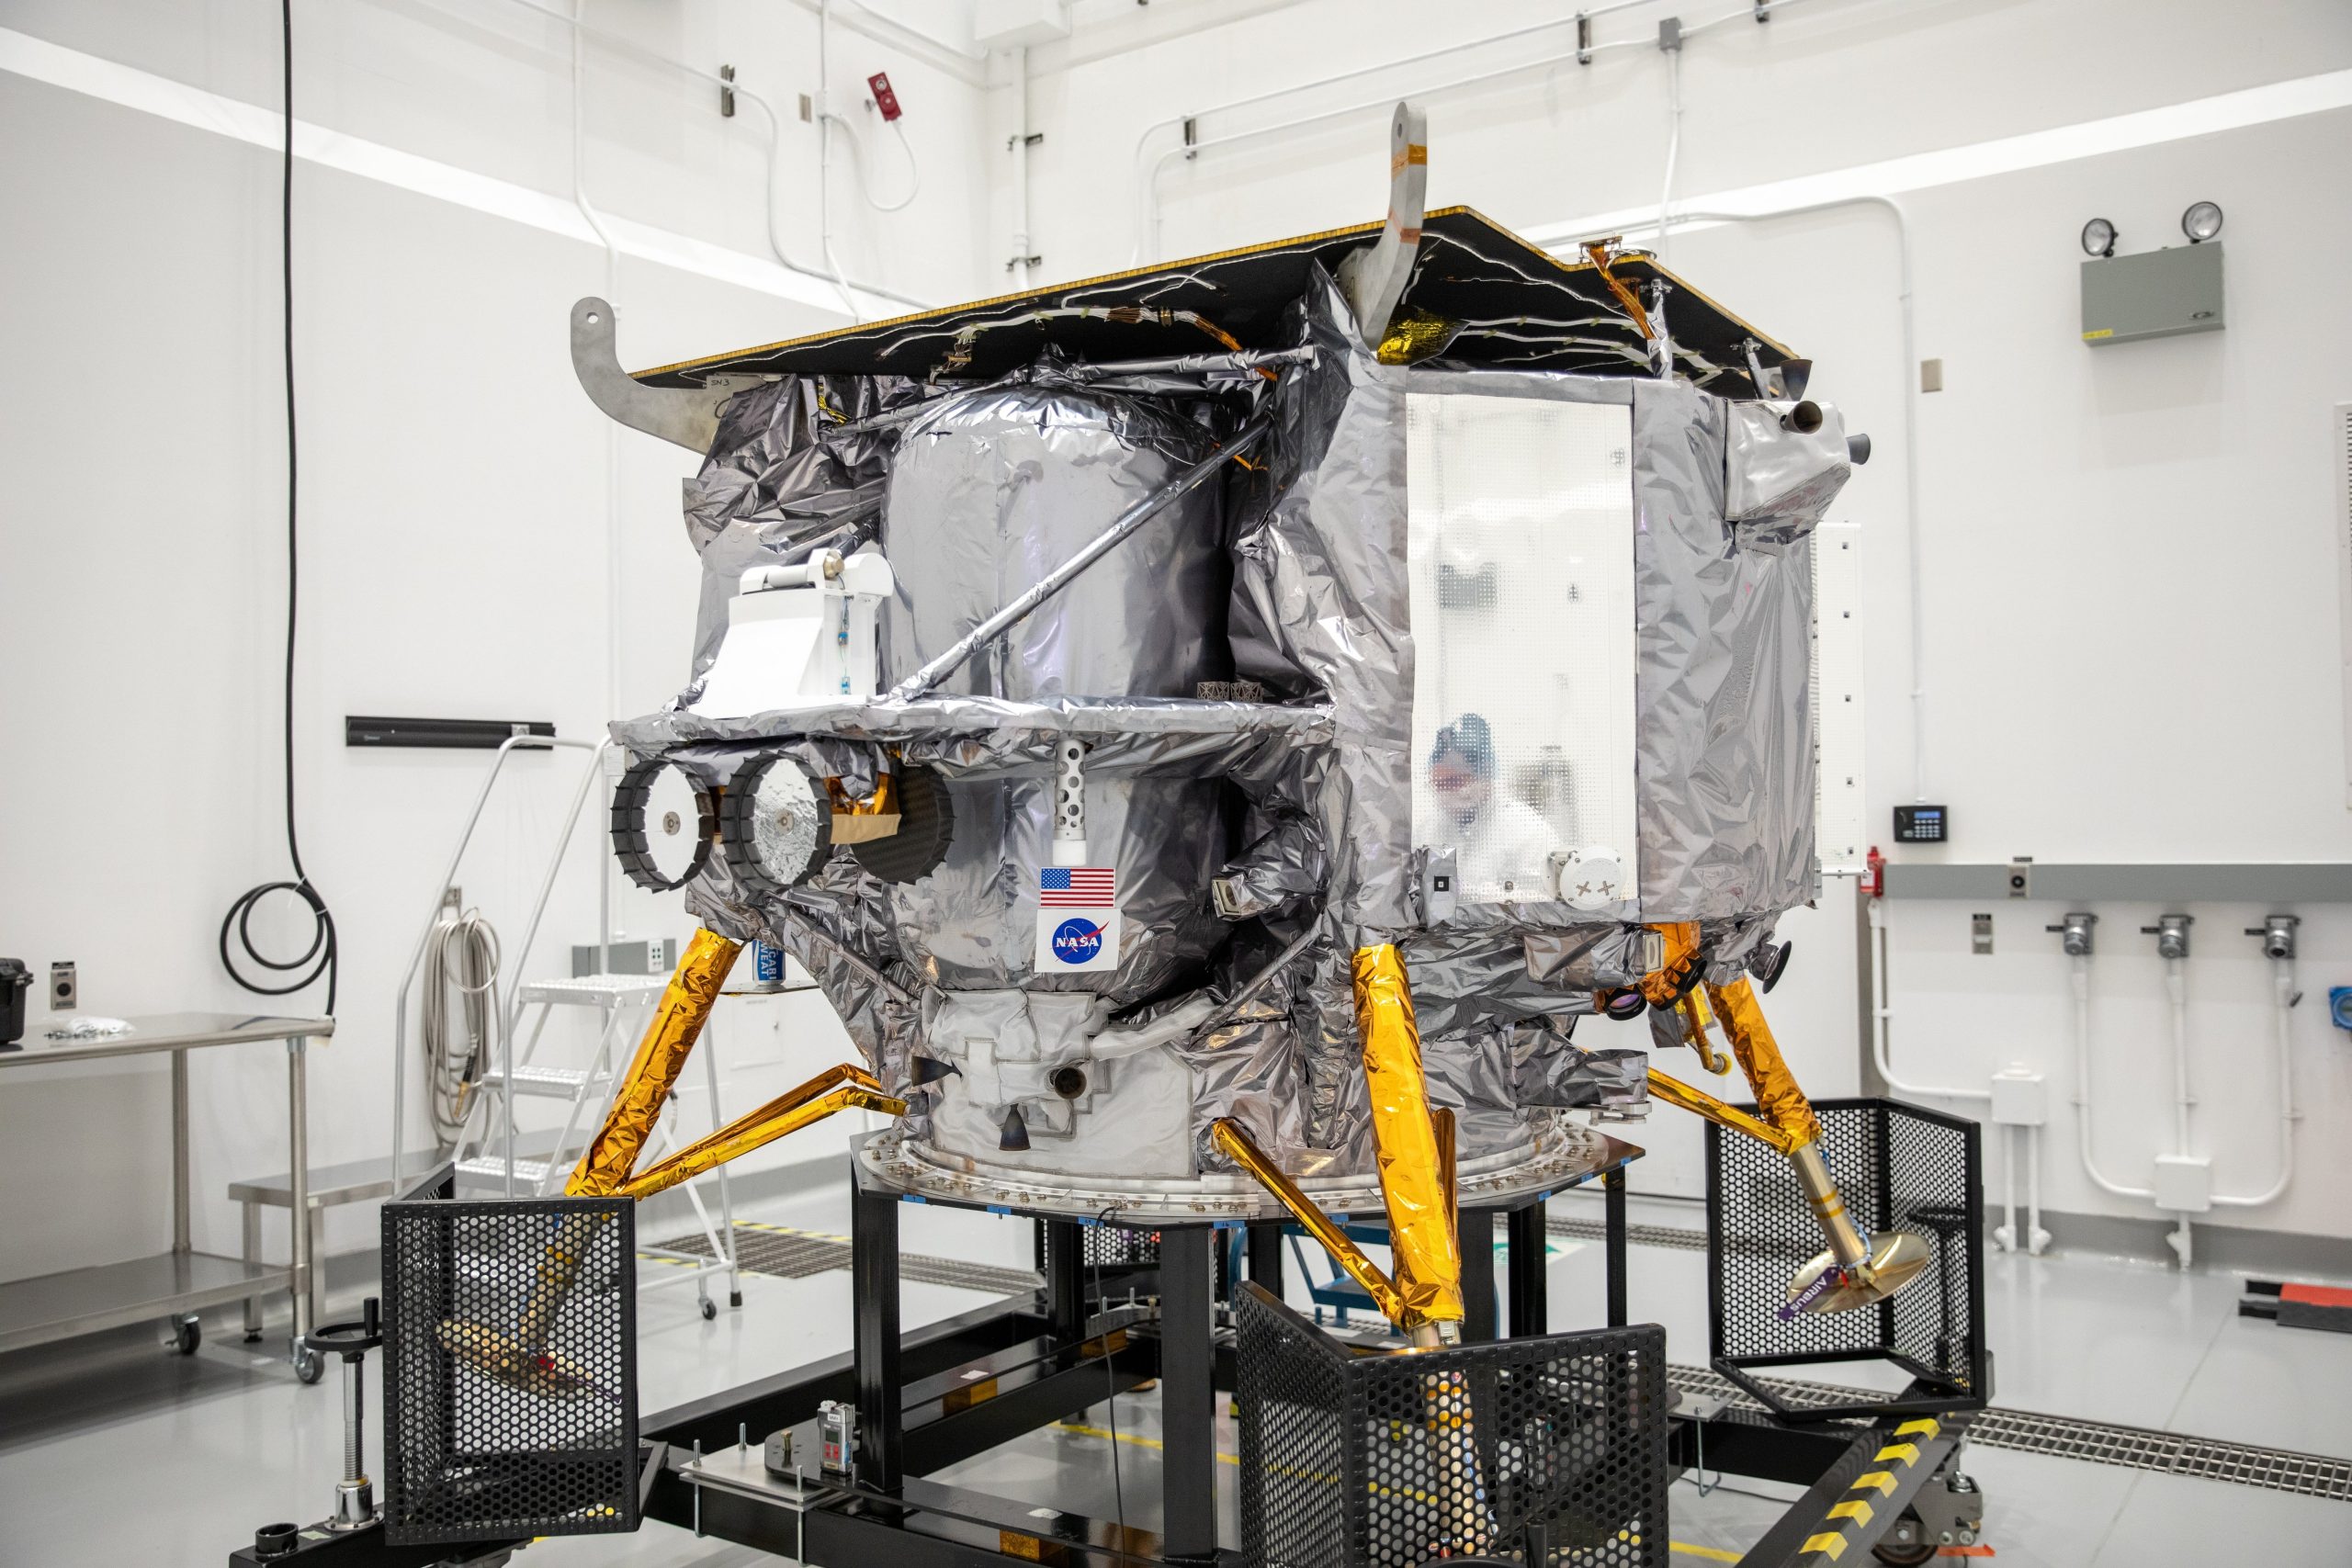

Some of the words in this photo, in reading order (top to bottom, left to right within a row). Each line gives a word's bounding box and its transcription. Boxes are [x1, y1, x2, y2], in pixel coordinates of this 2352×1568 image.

[760, 942, 769, 976] WEAT
[1056, 937, 1100, 947] NASA
[768, 946, 777, 980] CARI
[1789, 1276, 1827, 1312] AIRBUS
